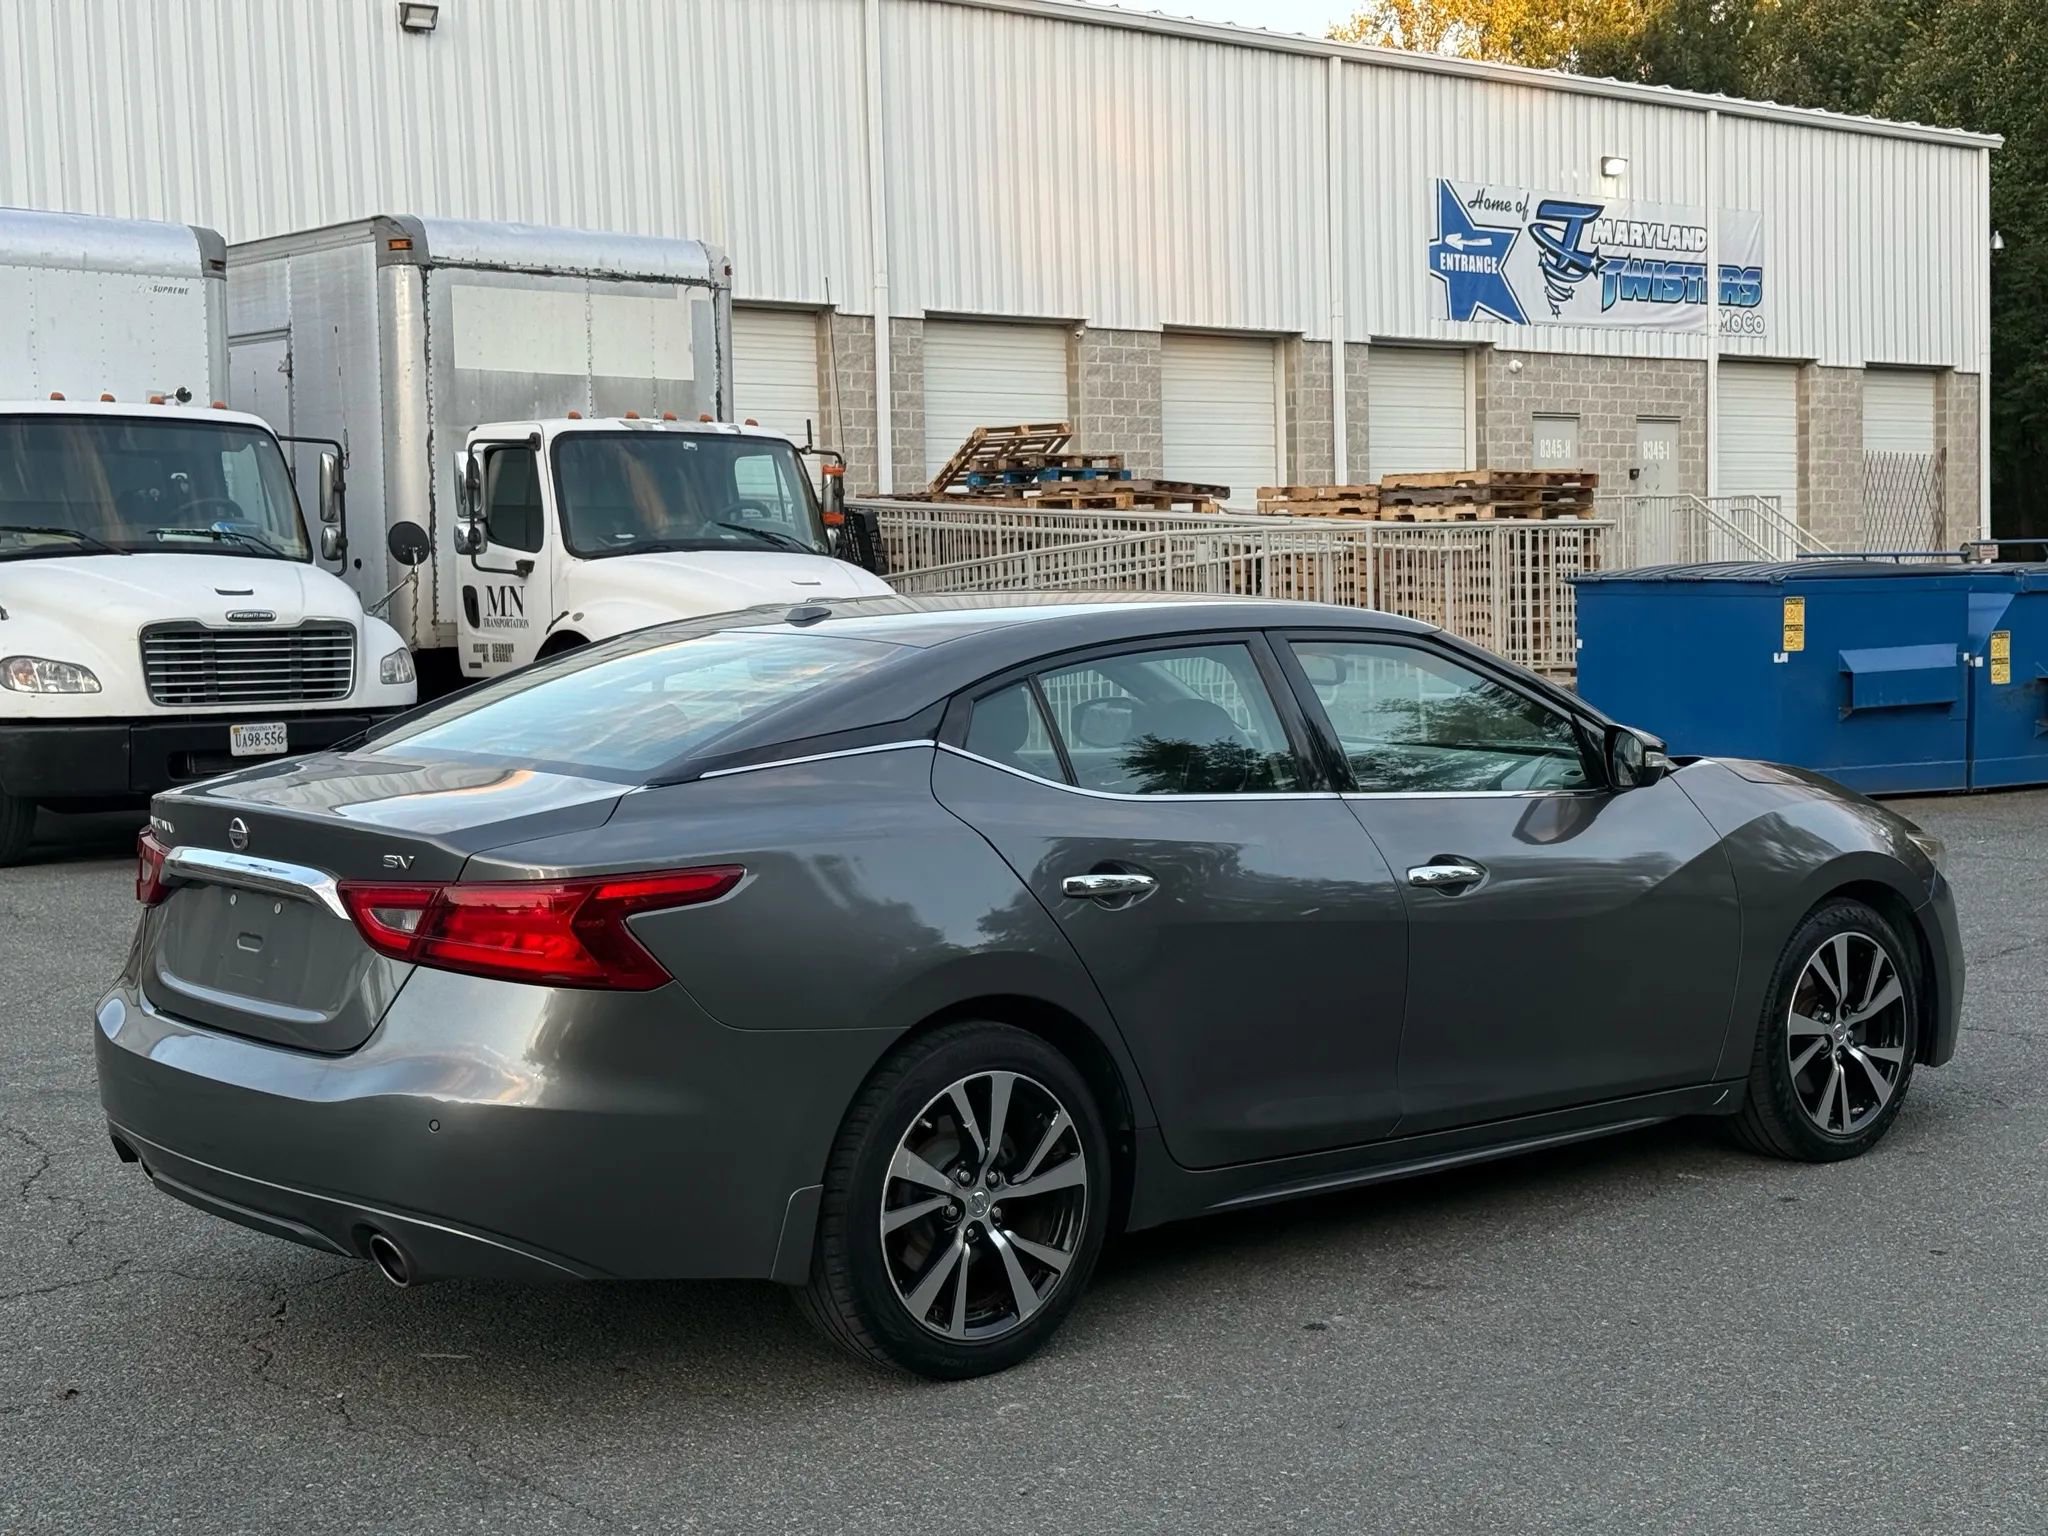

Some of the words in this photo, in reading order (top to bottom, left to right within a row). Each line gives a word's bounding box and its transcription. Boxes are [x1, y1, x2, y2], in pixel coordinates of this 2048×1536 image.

[1467, 188, 1512, 213] Home
[1515, 192, 1530, 222] of
[1591, 218, 1708, 252] MARYLAND
[1440, 252, 1498, 274] ENTRANCE
[152, 285, 190, 295] SUPREME
[1540, 439, 1571, 459] 8345-H
[486, 585, 525, 617] MN
[483, 618, 530, 629] TRANSPORTATION
[383, 855, 415, 869] SV
